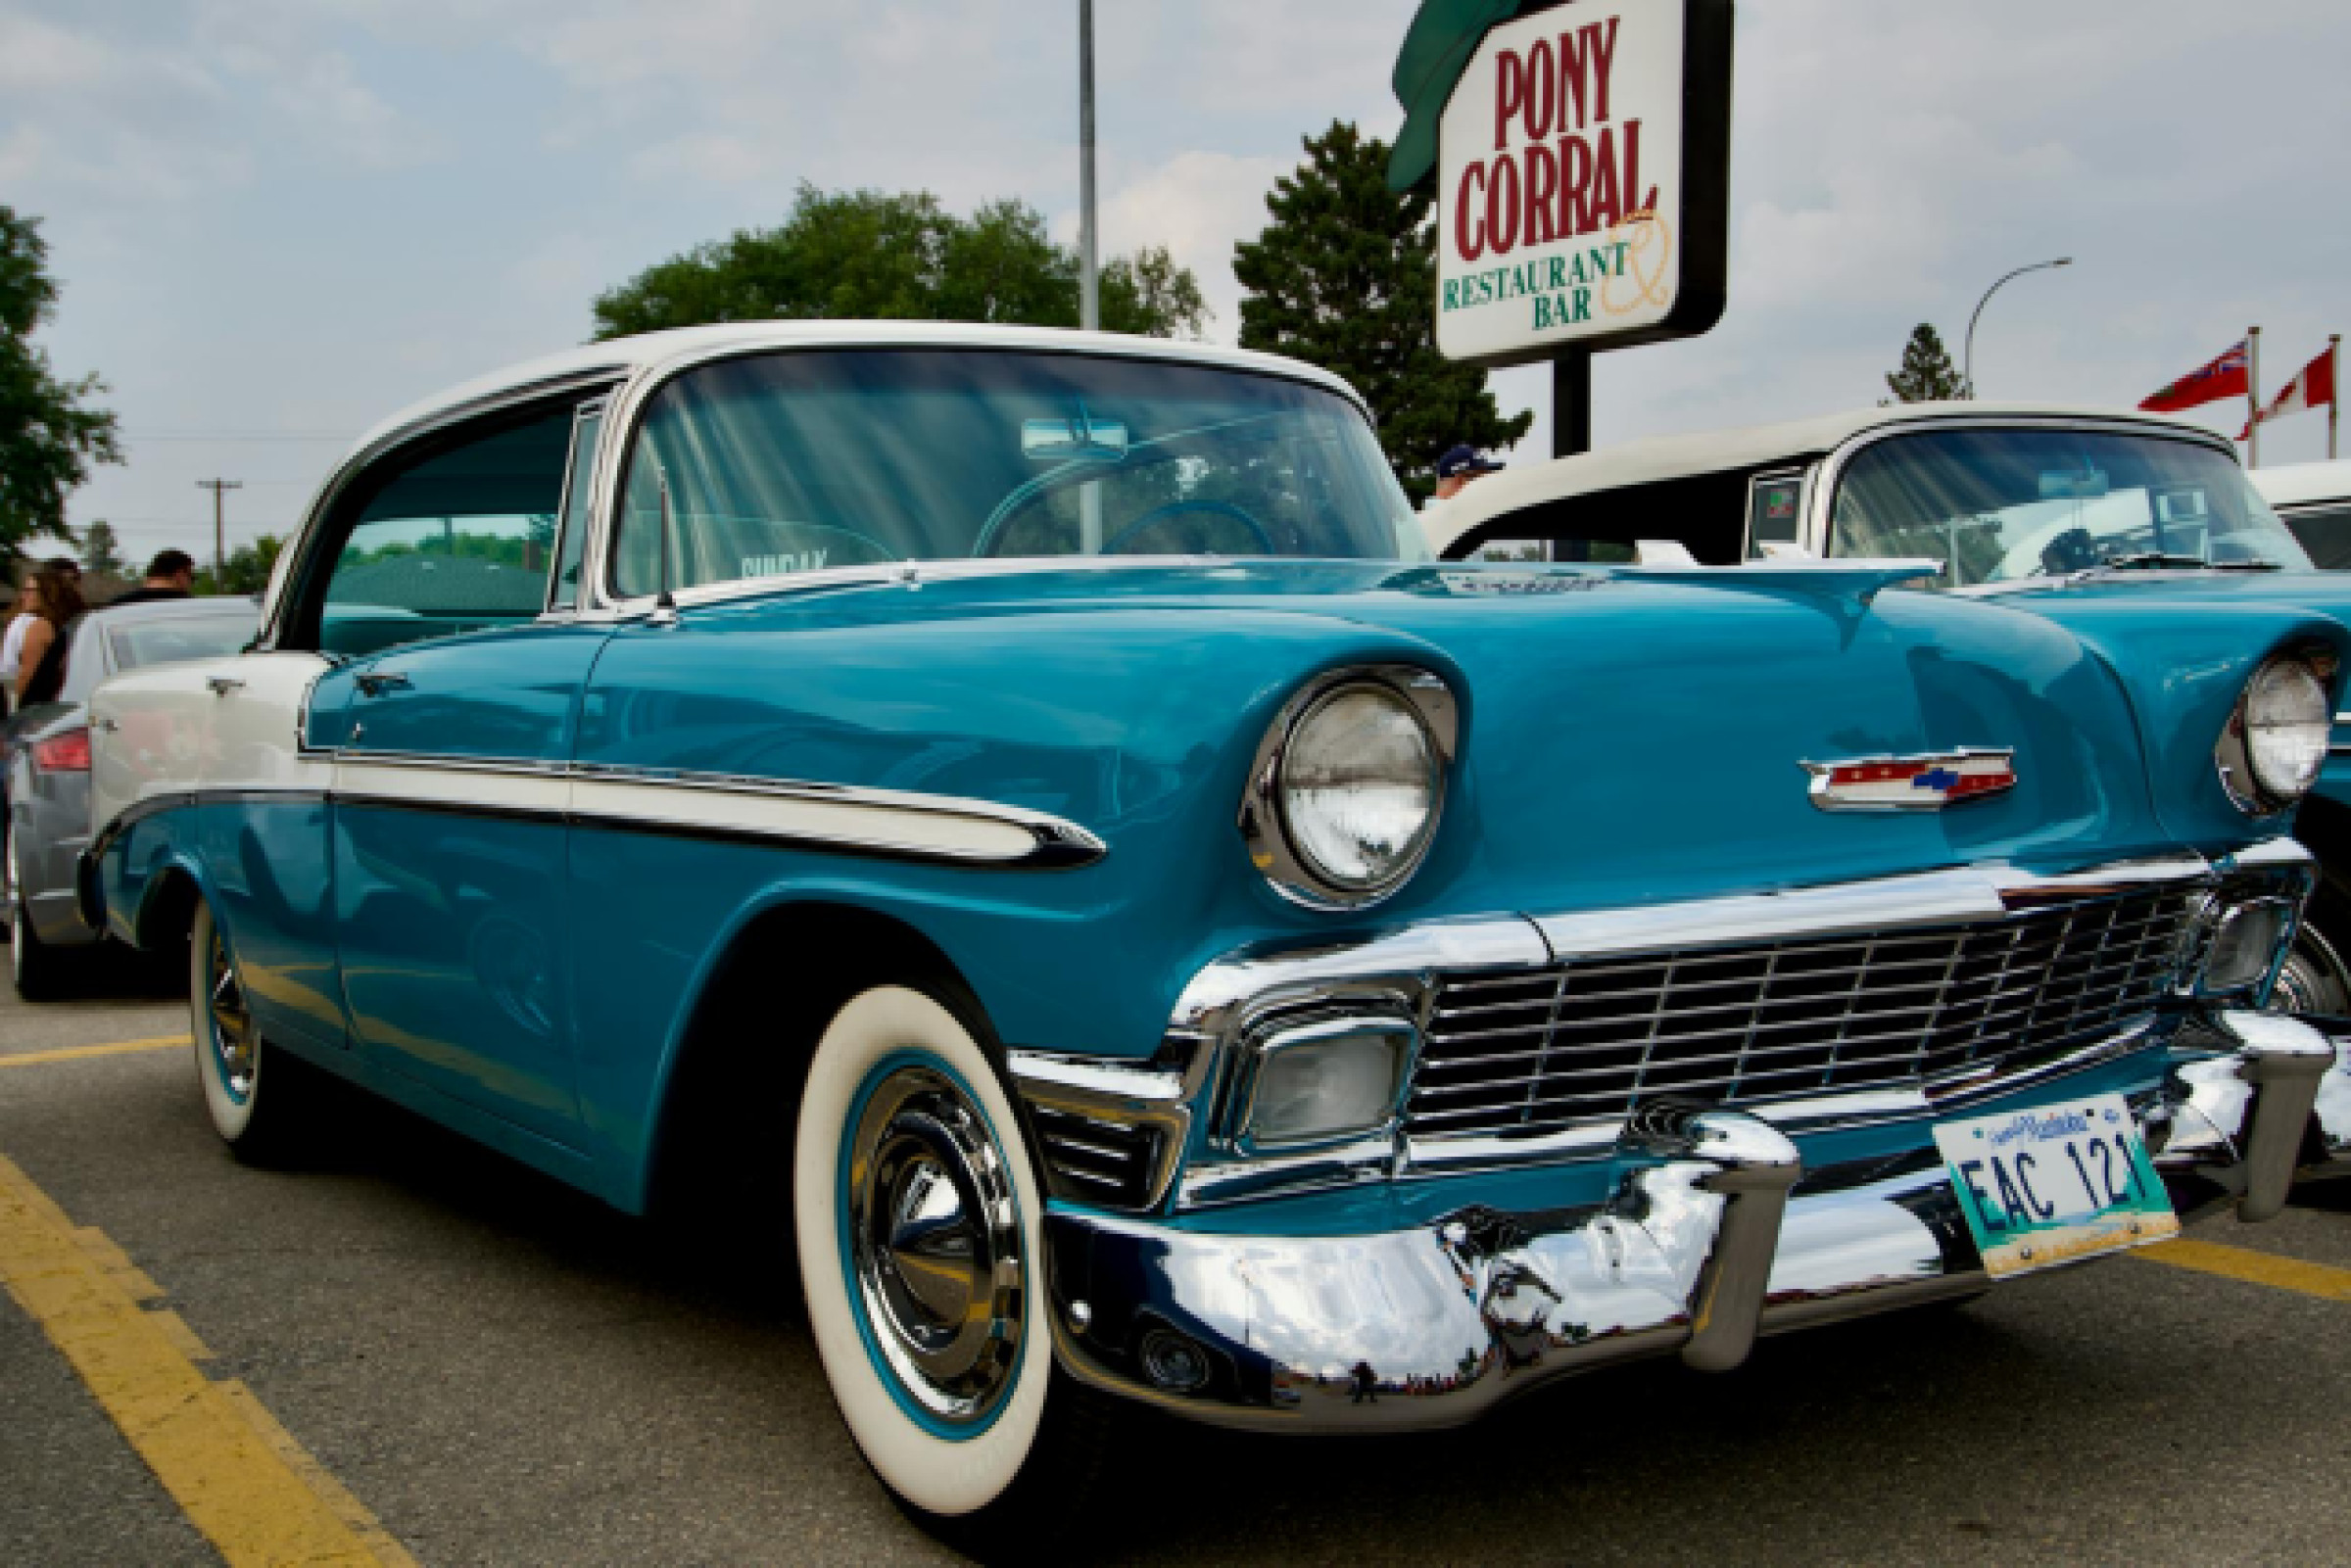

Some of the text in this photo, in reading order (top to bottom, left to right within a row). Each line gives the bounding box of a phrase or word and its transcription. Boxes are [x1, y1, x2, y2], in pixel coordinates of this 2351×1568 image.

[1494, 15, 1621, 151] PONY
[1454, 118, 1660, 262] CORRAL
[1443, 242, 1632, 311] RESTAURANT
[1532, 286, 1592, 331] BAR
[1959, 1131, 2146, 1232] EAC 121
